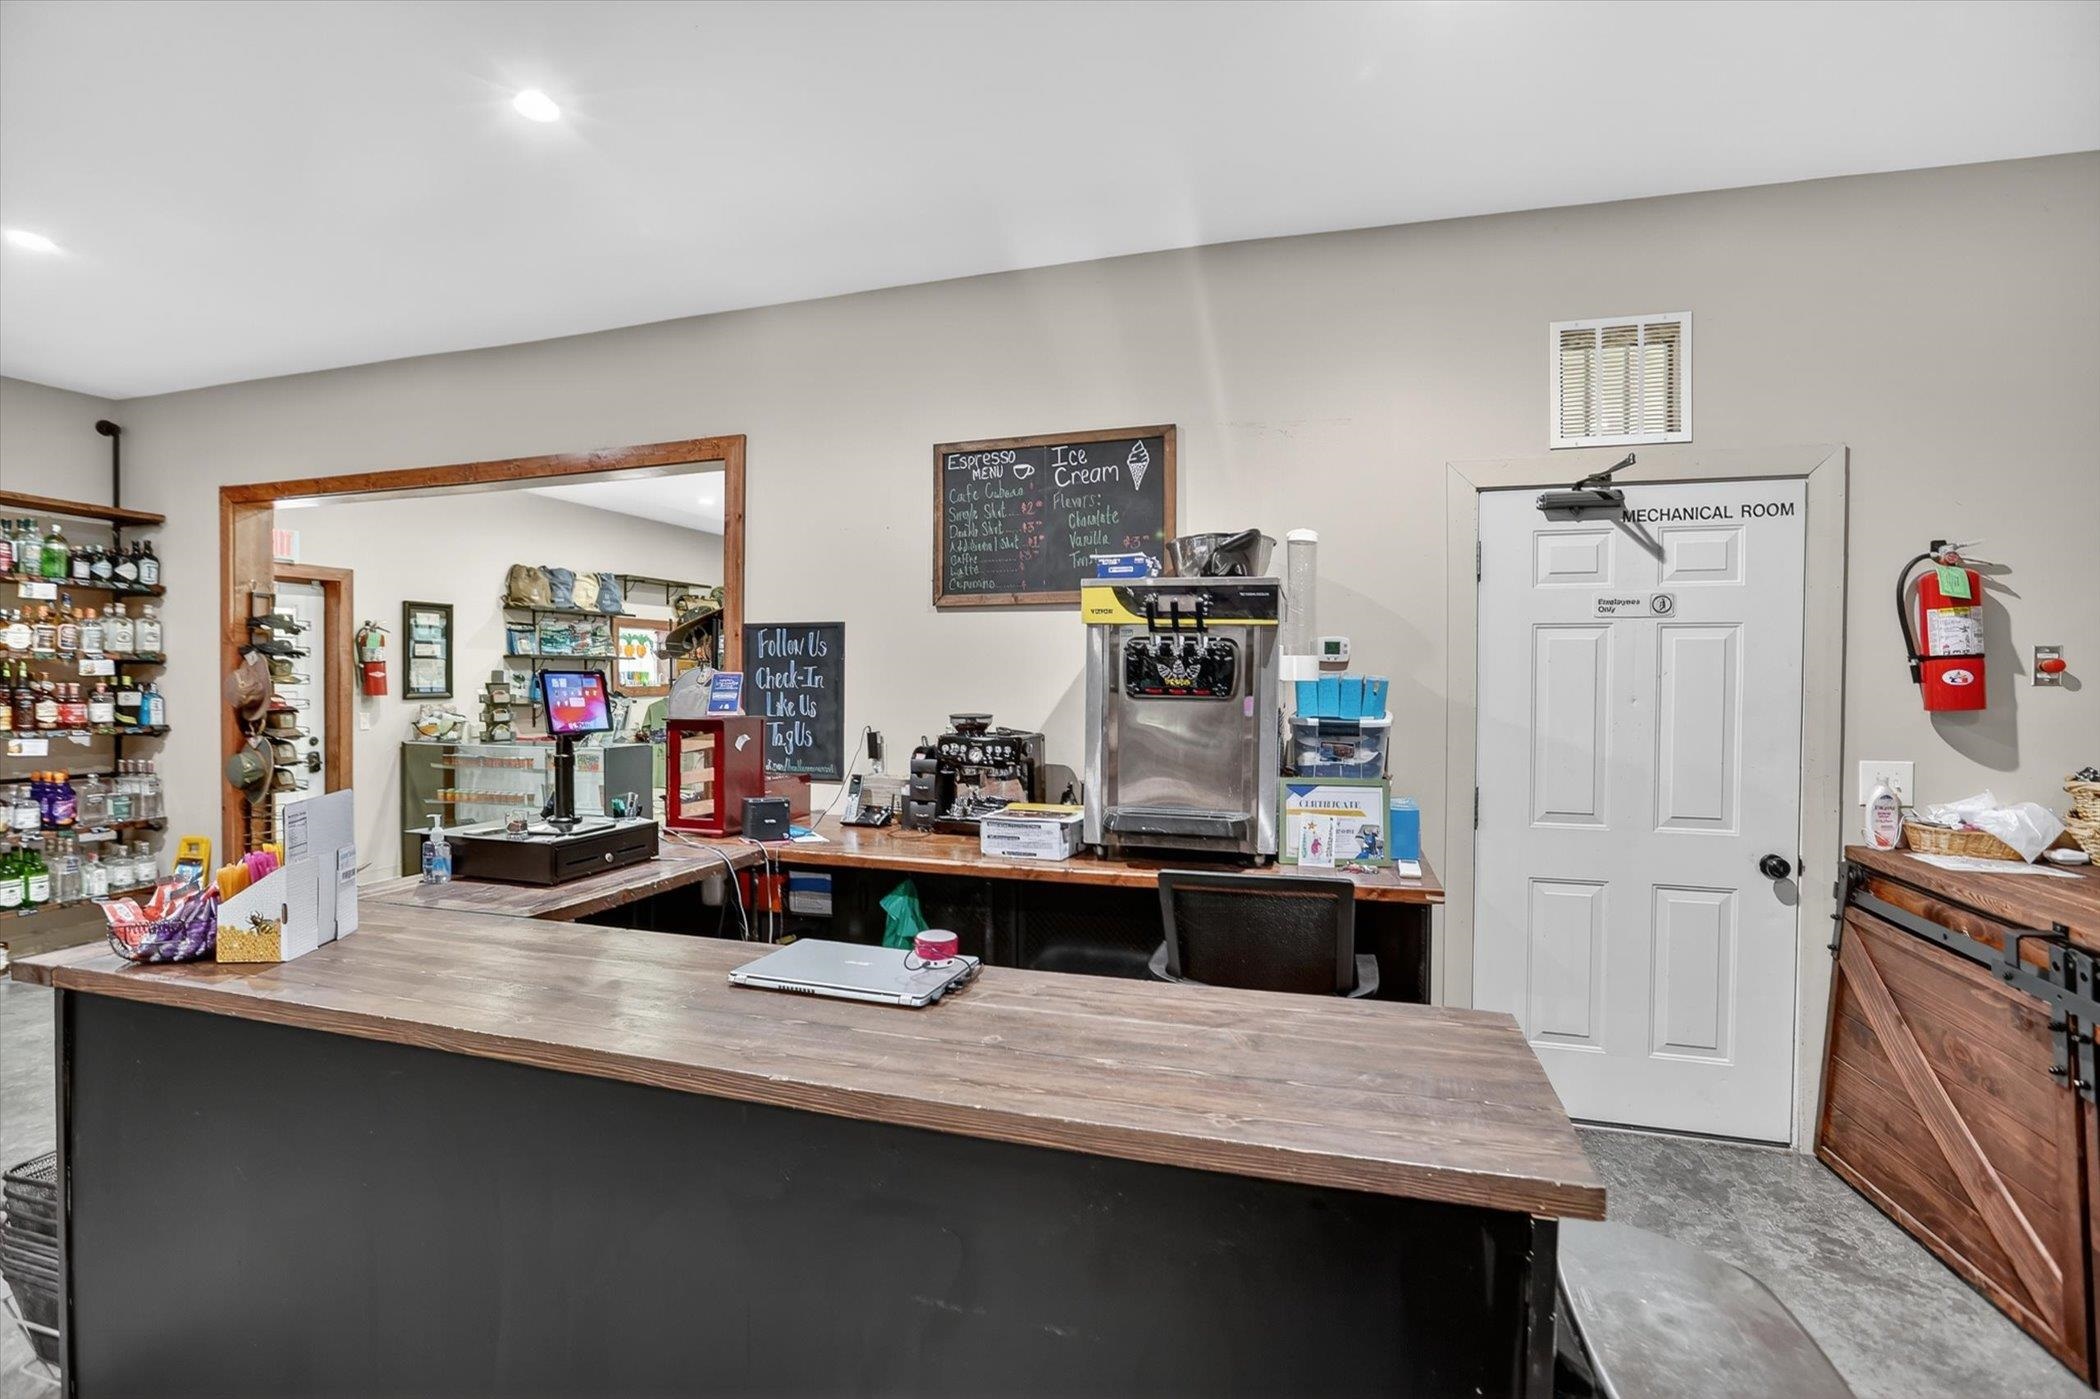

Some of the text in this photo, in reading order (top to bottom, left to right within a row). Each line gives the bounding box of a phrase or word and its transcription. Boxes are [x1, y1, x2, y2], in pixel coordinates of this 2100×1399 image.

[948, 450, 1016, 470] Espresso
[1051, 446, 1088, 467] Ice
[972, 465, 1004, 481] MENU
[1055, 465, 1119, 487] Cream
[1068, 504, 1120, 529] Chocolate
[1622, 503, 1794, 523] MECHANICAL ROOM
[1597, 598, 1640, 606] Employees
[1597, 606, 1616, 614] Only
[757, 628, 828, 658] Follow Us
[756, 660, 824, 690] Check-In
[766, 691, 817, 718] Like Us
